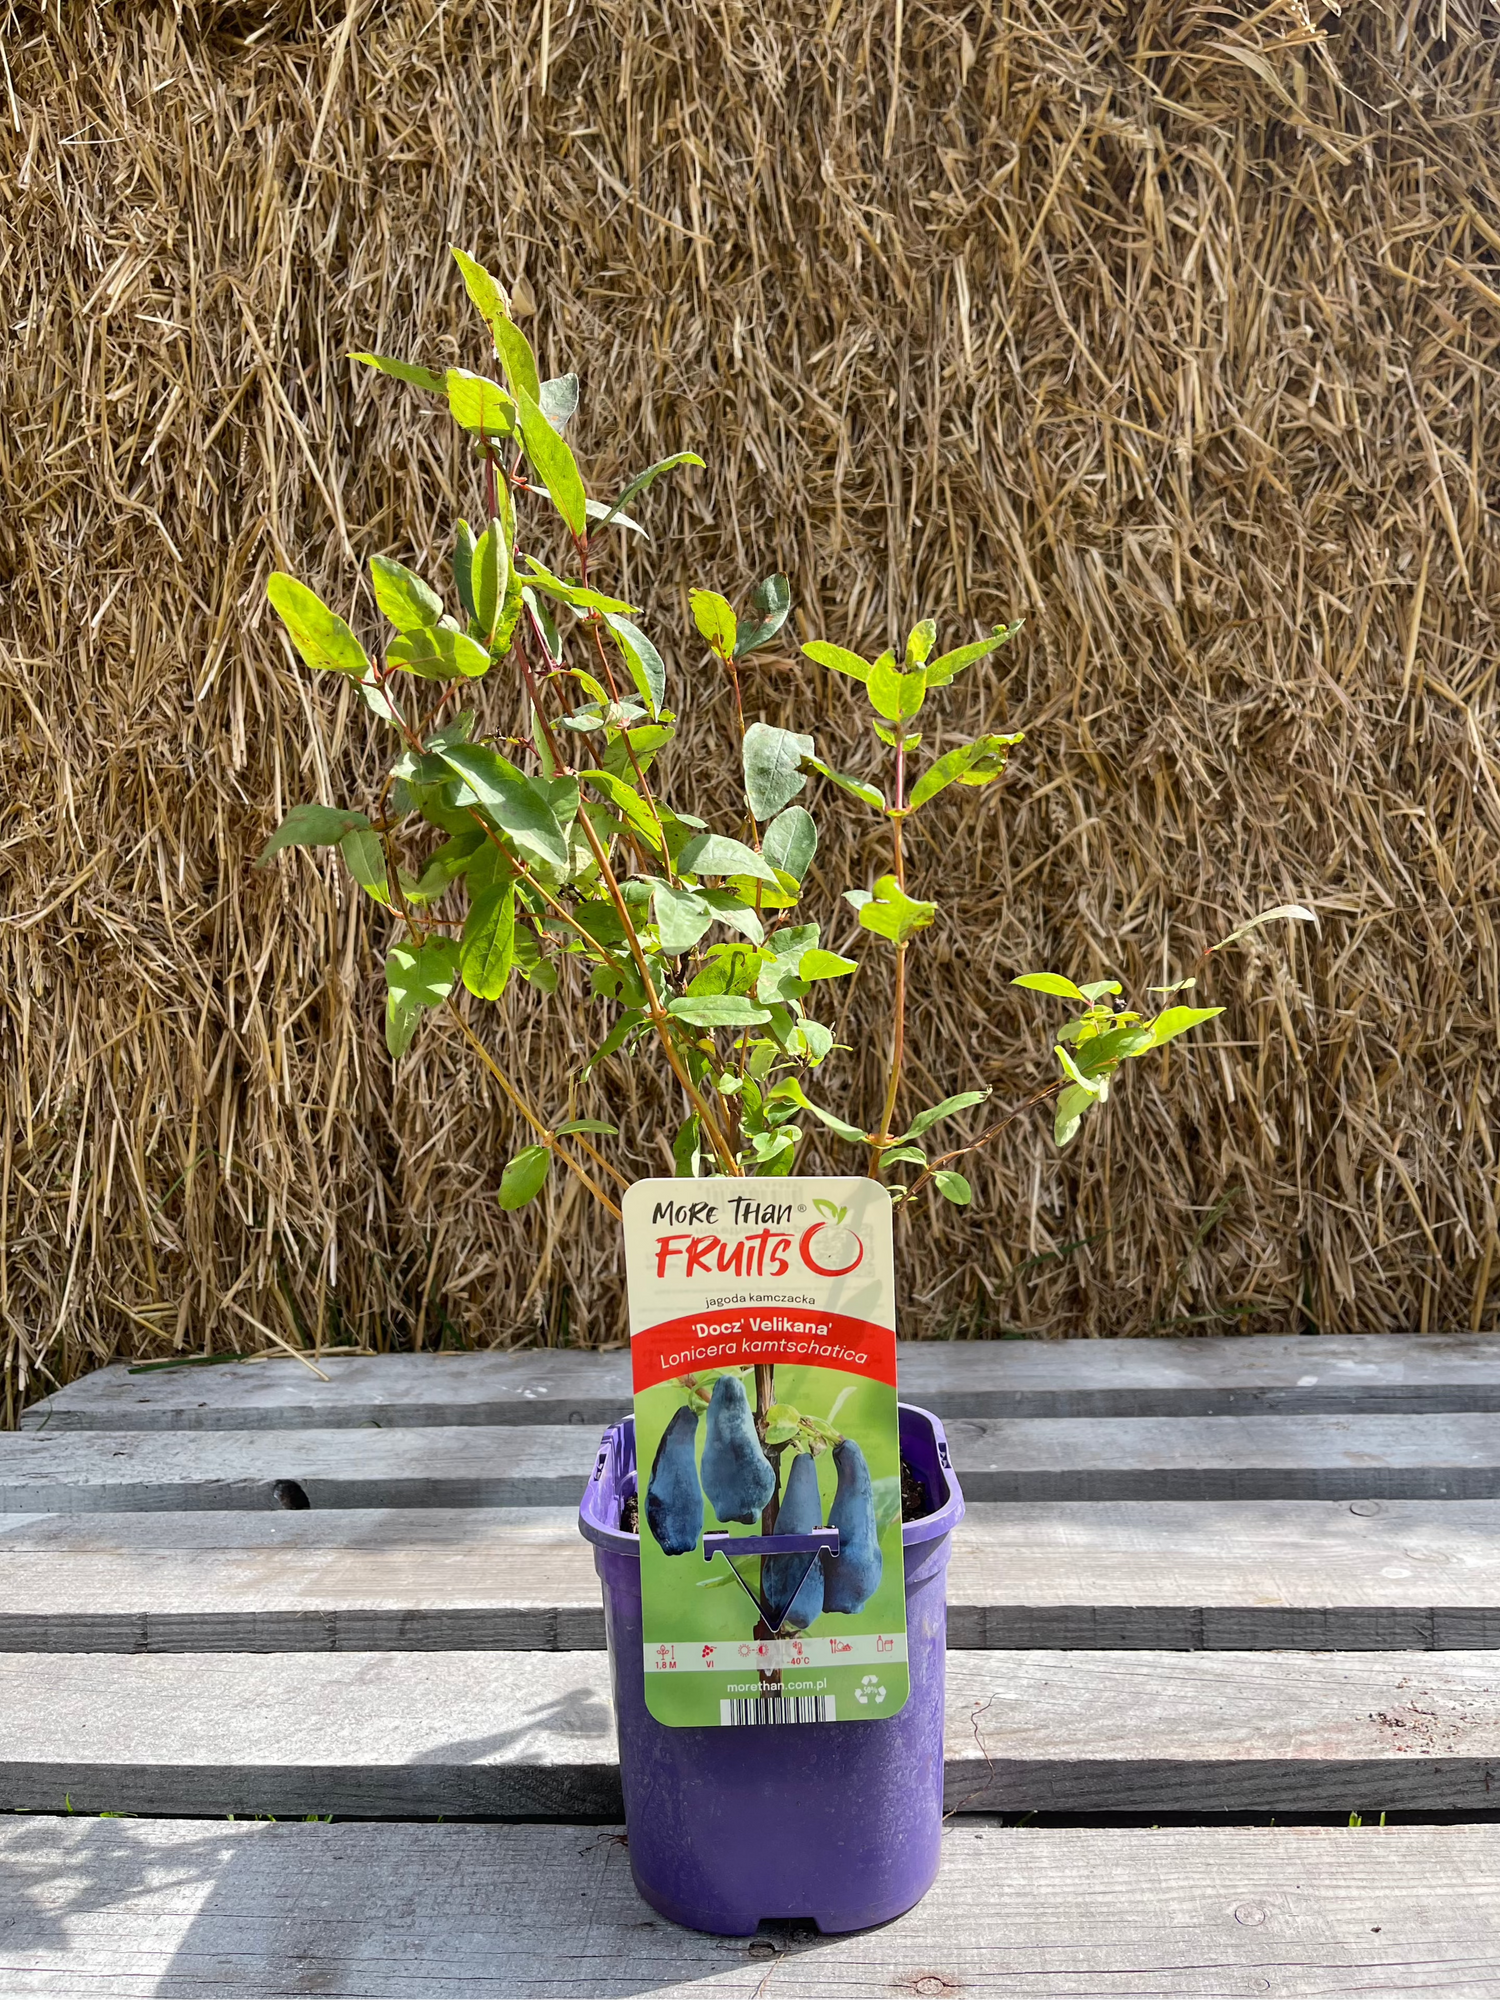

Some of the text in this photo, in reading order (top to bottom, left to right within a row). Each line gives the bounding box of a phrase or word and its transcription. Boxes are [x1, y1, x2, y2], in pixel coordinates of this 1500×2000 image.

[705, 1293, 816, 1309] jagoda kamczacka
[749, 1317, 832, 1336] Velikana'
[660, 1338, 868, 1369] Lonicera kamtschatica
[669, 1661, 677, 1669] M
[706, 1660, 714, 1668] VI
[727, 1678, 827, 1692] morethan.com.pl
